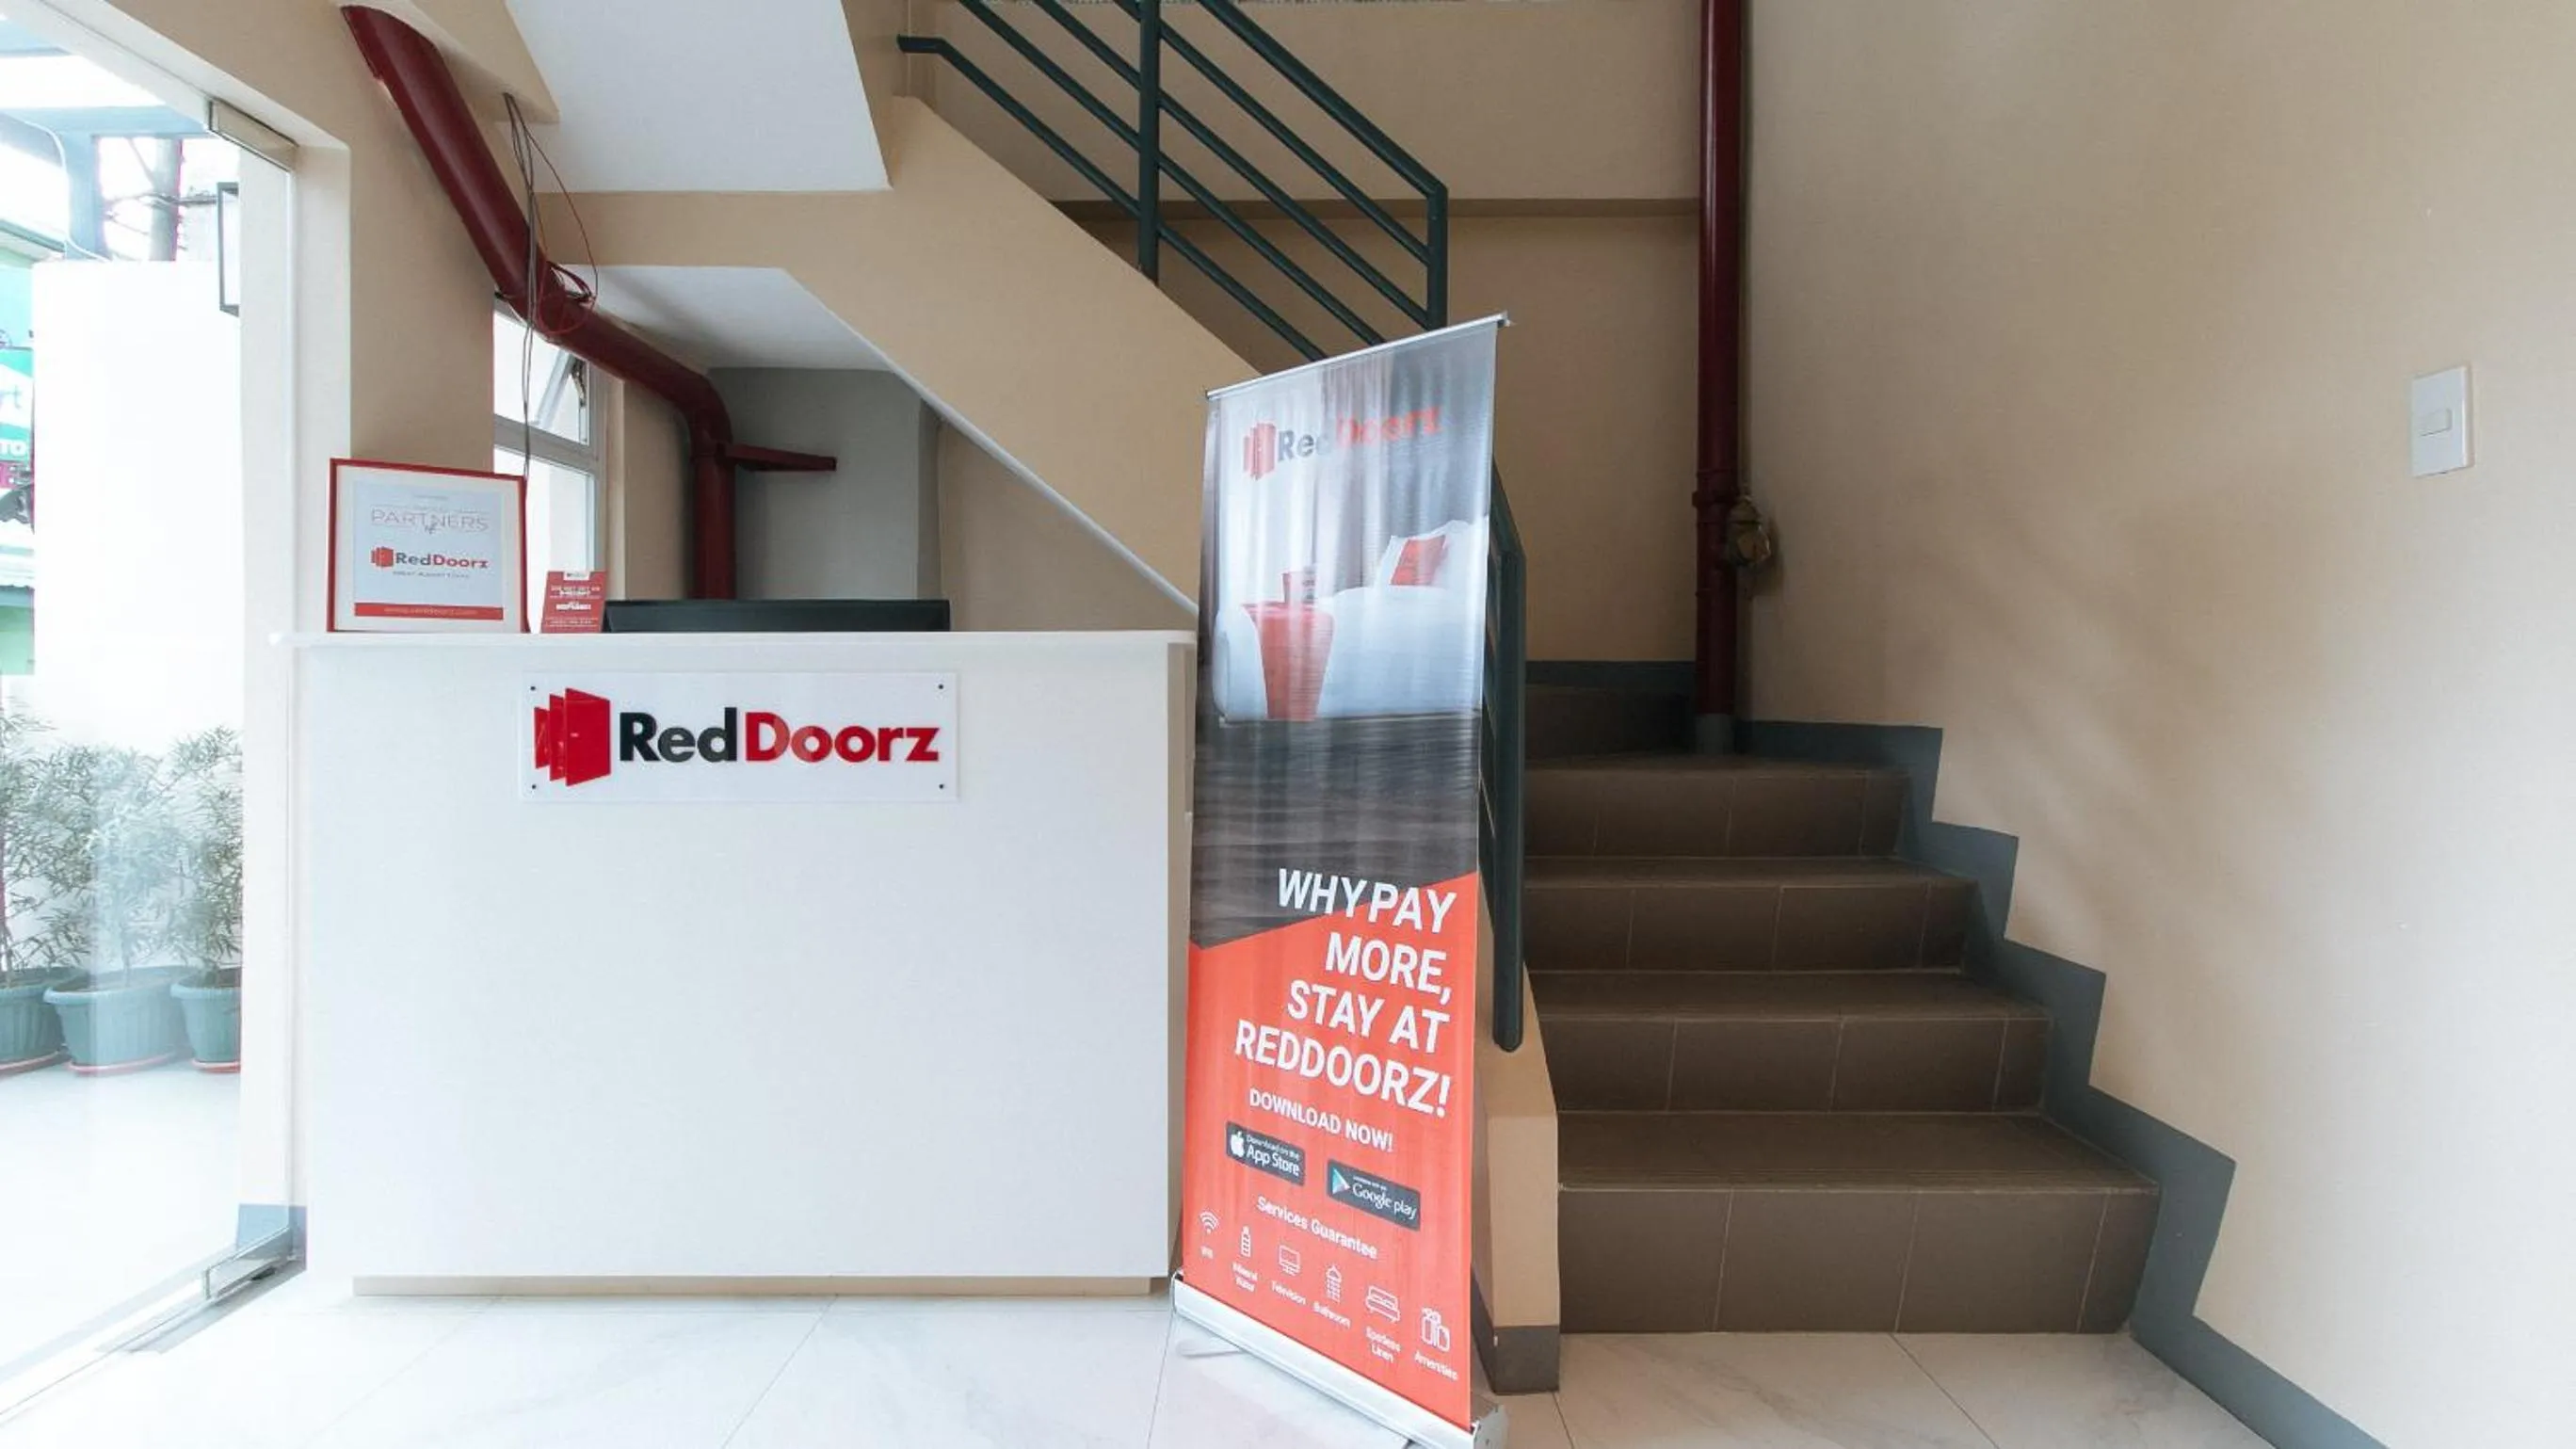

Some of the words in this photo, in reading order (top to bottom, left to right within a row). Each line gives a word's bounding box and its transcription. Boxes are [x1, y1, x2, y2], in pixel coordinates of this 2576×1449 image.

[371, 508, 489, 531] PARTNERS
[395, 552, 489, 569] RedDoorz
[620, 707, 940, 763] RedDoorz
[1278, 868, 1367, 918] WHY
[1367, 882, 1457, 933] PAY
[1325, 932, 1452, 1005] MORE,
[1287, 980, 1385, 1038] STAY
[1389, 1006, 1450, 1054] AT
[1234, 1019, 1451, 1118] REDDOORZ!
[1249, 1088, 1341, 1134] DOWNLOAD
[1345, 1119, 1393, 1152] NOW!
[1246, 1144, 1271, 1167] App
[1272, 1152, 1299, 1177] Store
[1256, 1196, 1308, 1231] Services
[1311, 1217, 1377, 1260] Guarantee
[1353, 1183, 1393, 1209] Google
[1393, 1200, 1417, 1220] play
